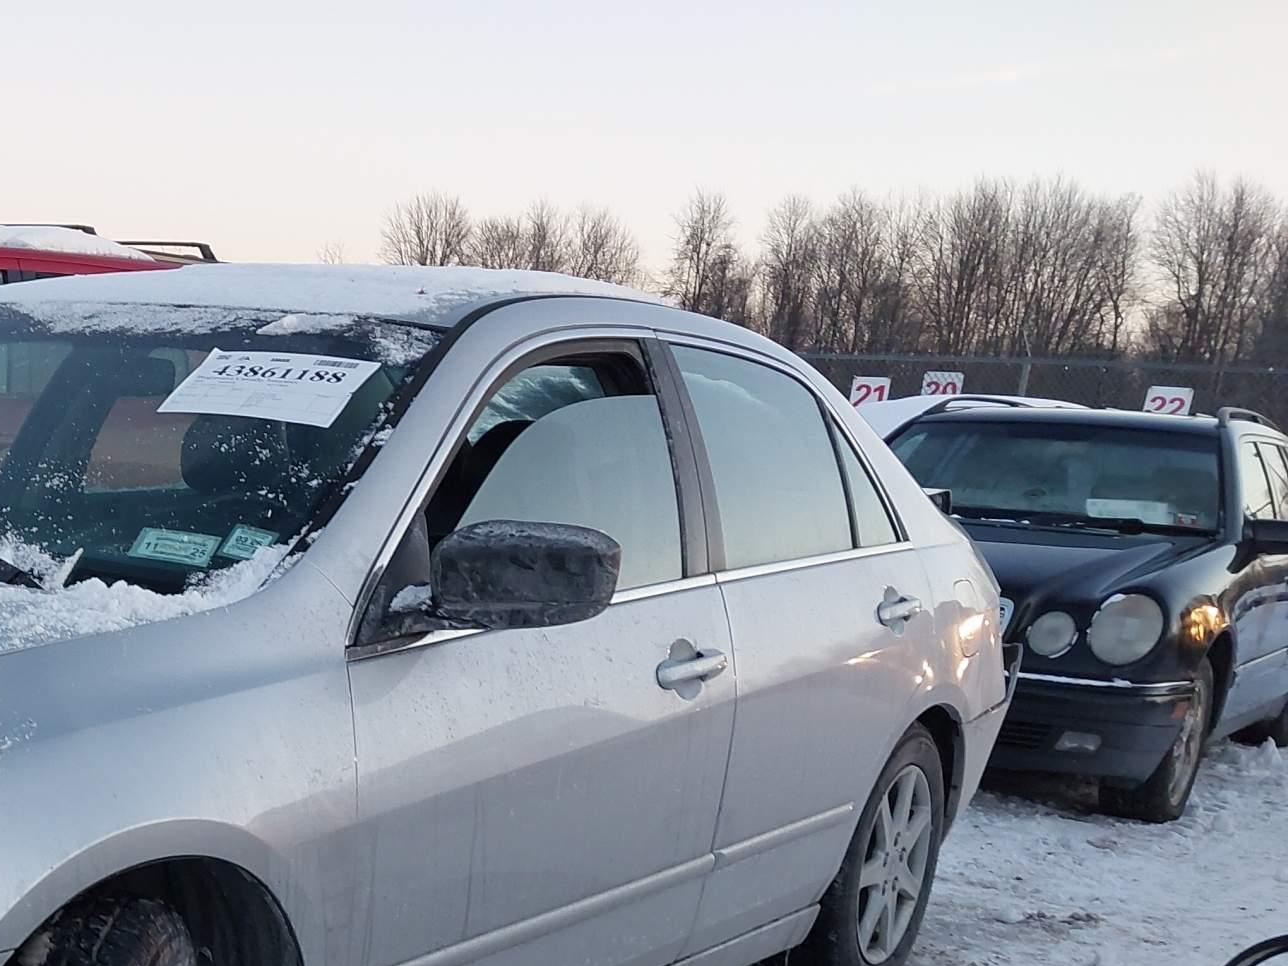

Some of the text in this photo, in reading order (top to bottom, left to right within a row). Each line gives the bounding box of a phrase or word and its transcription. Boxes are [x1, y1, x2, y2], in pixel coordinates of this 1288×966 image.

[213, 365, 346, 383] 43861188
[853, 384, 885, 407] 21
[1150, 396, 1185, 414] 22
[145, 541, 159, 551] 11
[188, 546, 207, 558] 25
